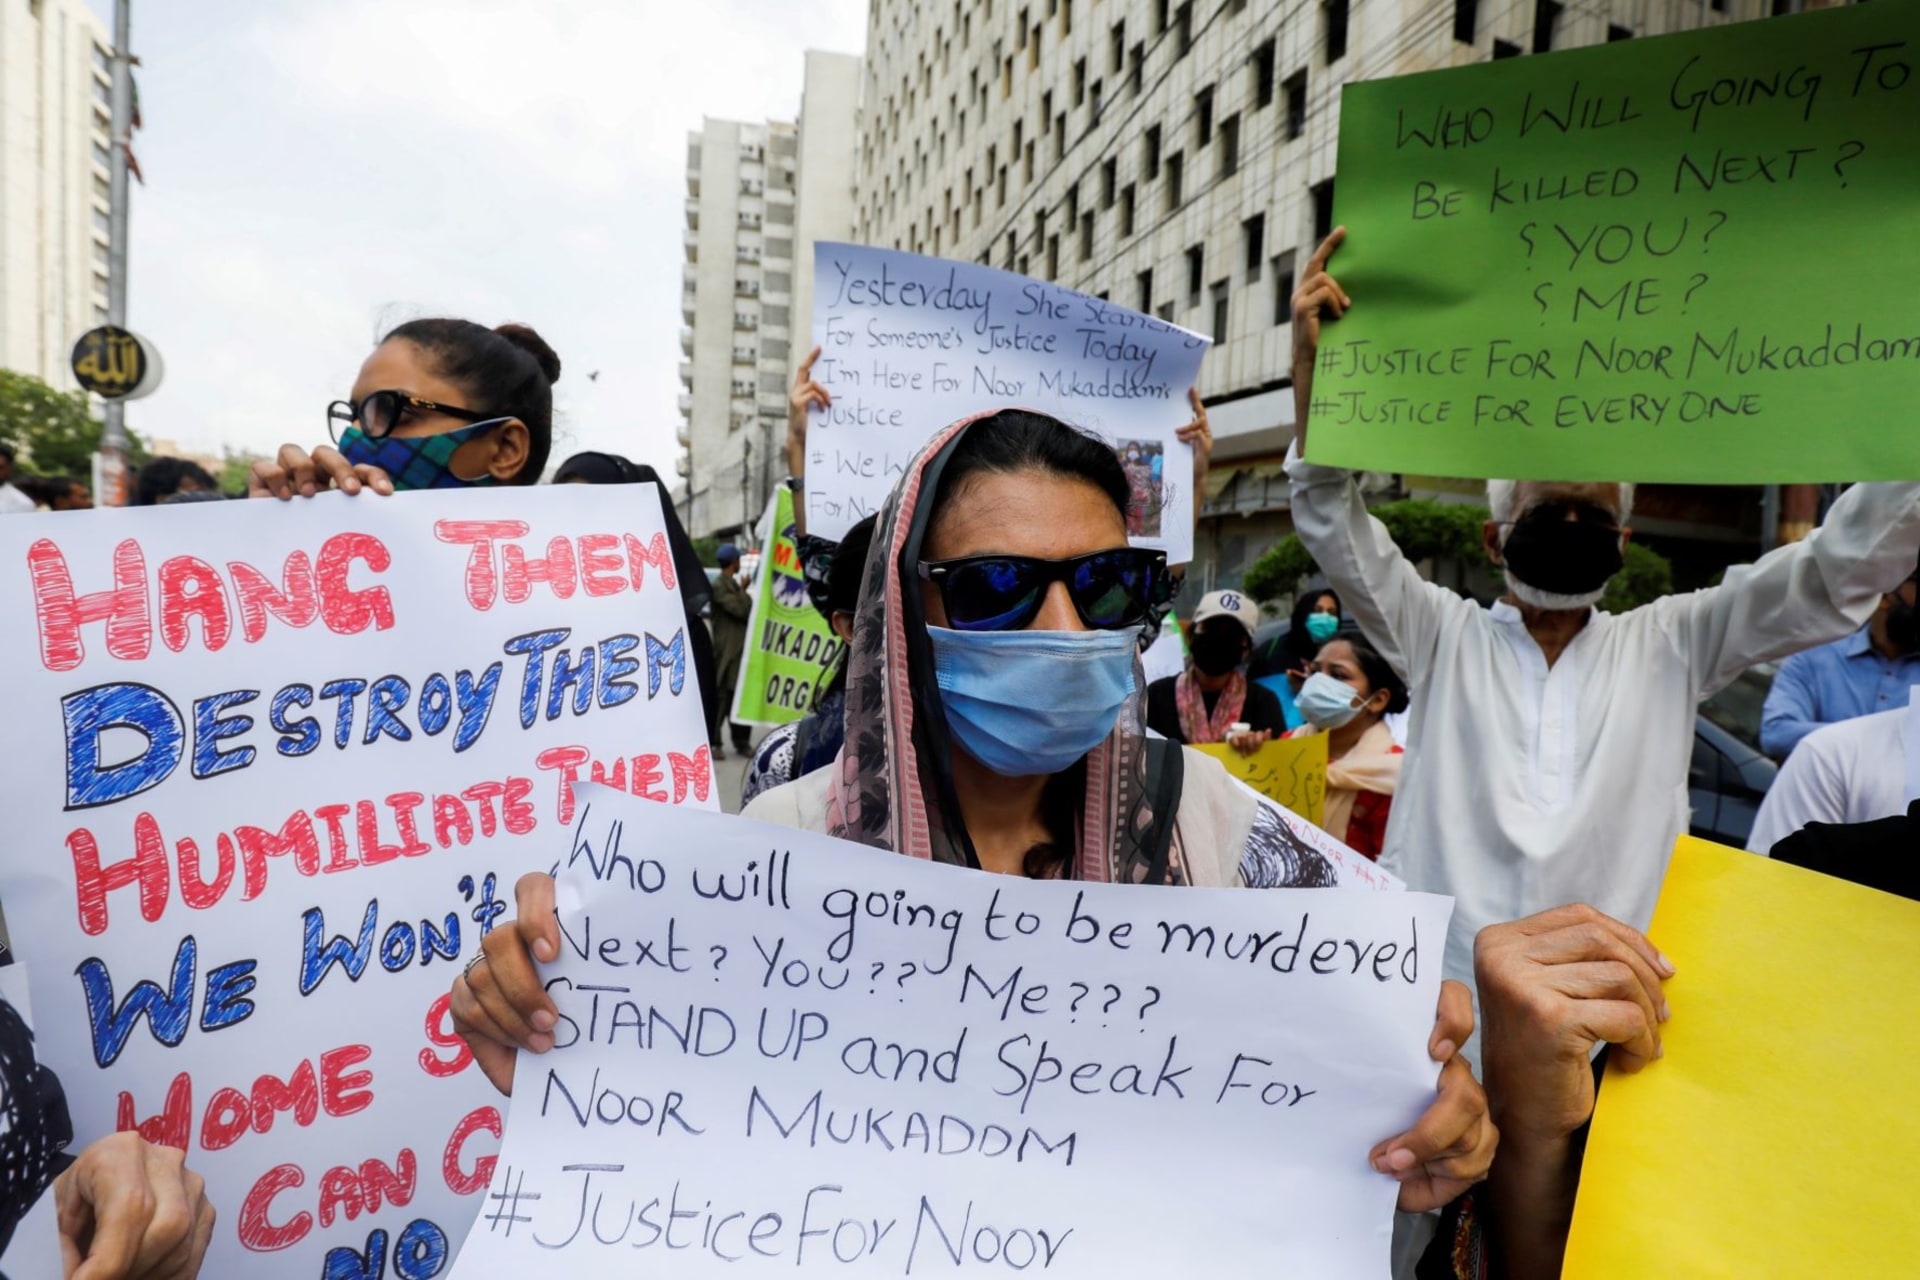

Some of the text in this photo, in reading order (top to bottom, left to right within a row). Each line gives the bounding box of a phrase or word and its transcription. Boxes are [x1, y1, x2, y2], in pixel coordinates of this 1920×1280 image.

[1396, 40, 1911, 151] WHO WILL GOING TO
[1411, 180, 1465, 220] BE
[827, 259, 992, 333] Yesterday
[1016, 283, 1070, 320] She
[824, 316, 855, 347] For
[977, 323, 1058, 356] Justice
[1075, 328, 1158, 385] Today
[873, 361, 924, 392] Here
[932, 362, 961, 393] For
[972, 365, 1026, 397] Noor
[1486, 339, 1557, 381] FOR
[1575, 337, 1674, 381] NOOR
[817, 395, 904, 428] Justice
[1474, 395, 1534, 428] FOR
[810, 492, 842, 519] For
[27, 520, 676, 671] HANG THEM
[61, 626, 686, 811] DESTROY THEM
[65, 776, 538, 936] HUMILIATE
[567, 802, 1420, 985] Who will going to be murdered
[74, 935, 257, 1070] WE
[545, 977, 1317, 1115] STAND UP and Speak For
[540, 1067, 706, 1137] NOOR
[239, 1147, 416, 1253] CAN
